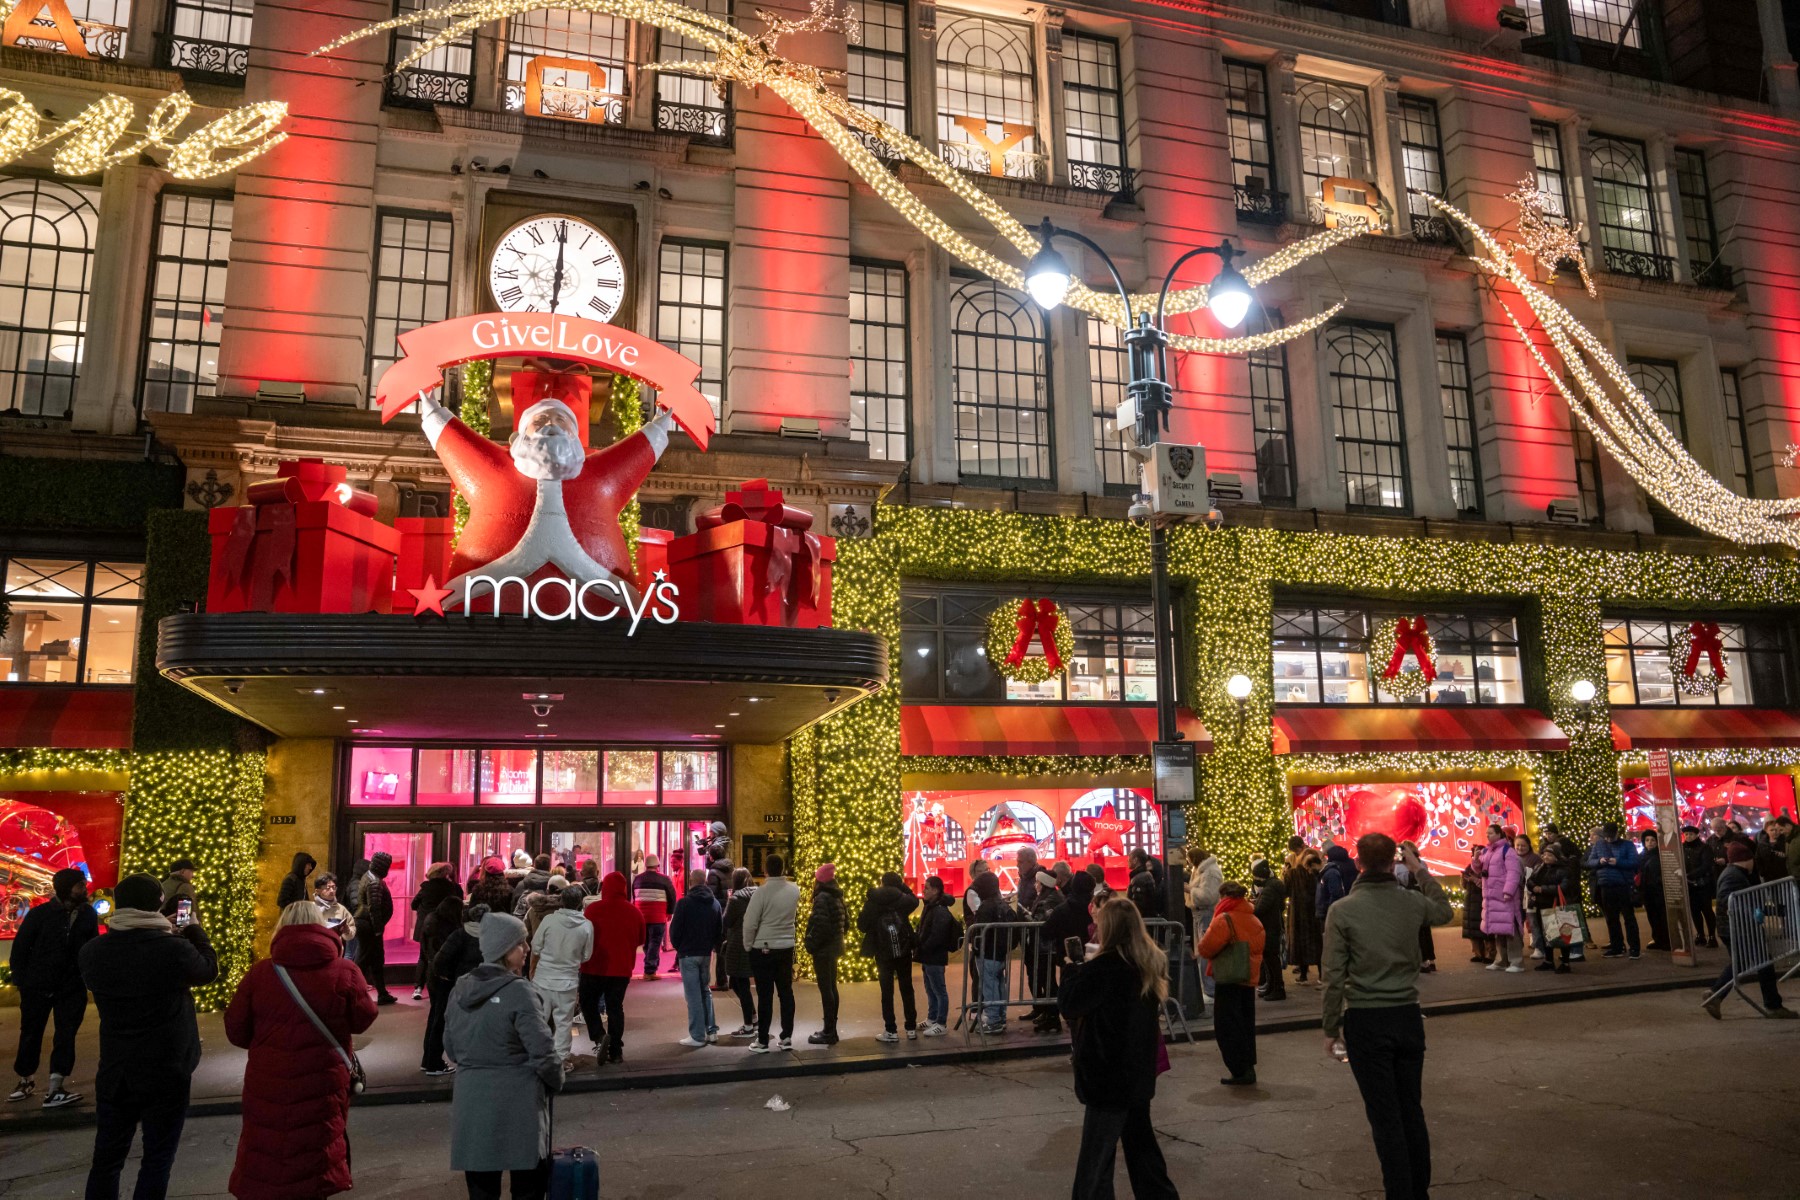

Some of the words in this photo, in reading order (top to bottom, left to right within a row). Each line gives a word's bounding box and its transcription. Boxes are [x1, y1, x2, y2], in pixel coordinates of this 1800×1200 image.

[2, 0, 90, 58] A
[524, 55, 606, 125] C
[954, 114, 1036, 178] Y
[553, 223, 568, 244] XI
[472, 317, 550, 349] Give
[557, 321, 639, 366] Love
[464, 568, 679, 637] macy's
